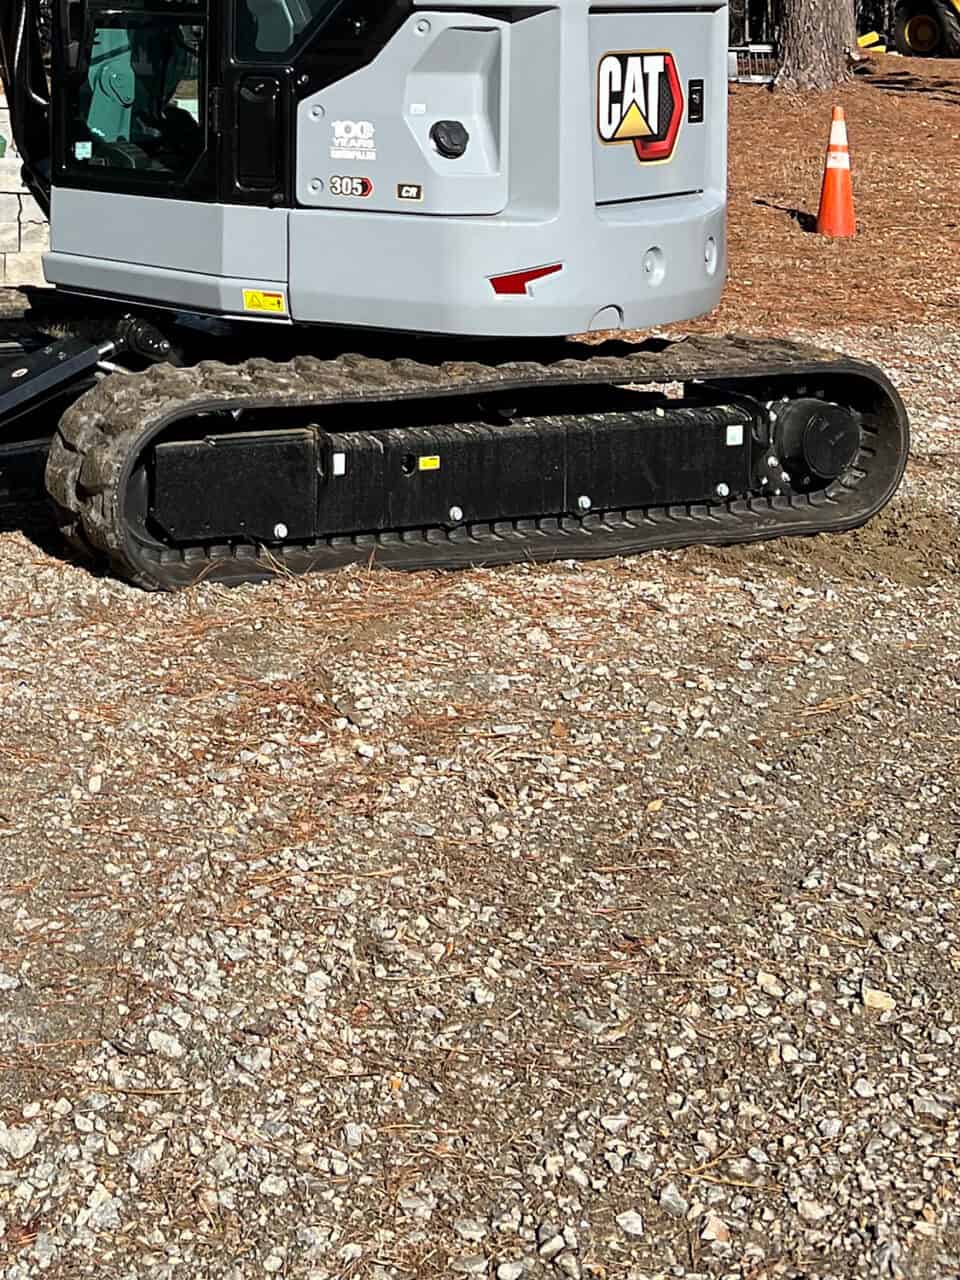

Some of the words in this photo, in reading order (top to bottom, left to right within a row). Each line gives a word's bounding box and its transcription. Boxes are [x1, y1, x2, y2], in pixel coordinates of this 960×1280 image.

[599, 55, 665, 140] CAT
[331, 120, 374, 138] 100
[332, 137, 375, 148] YEARS
[330, 176, 363, 195] 305
[401, 186, 418, 197] CR
